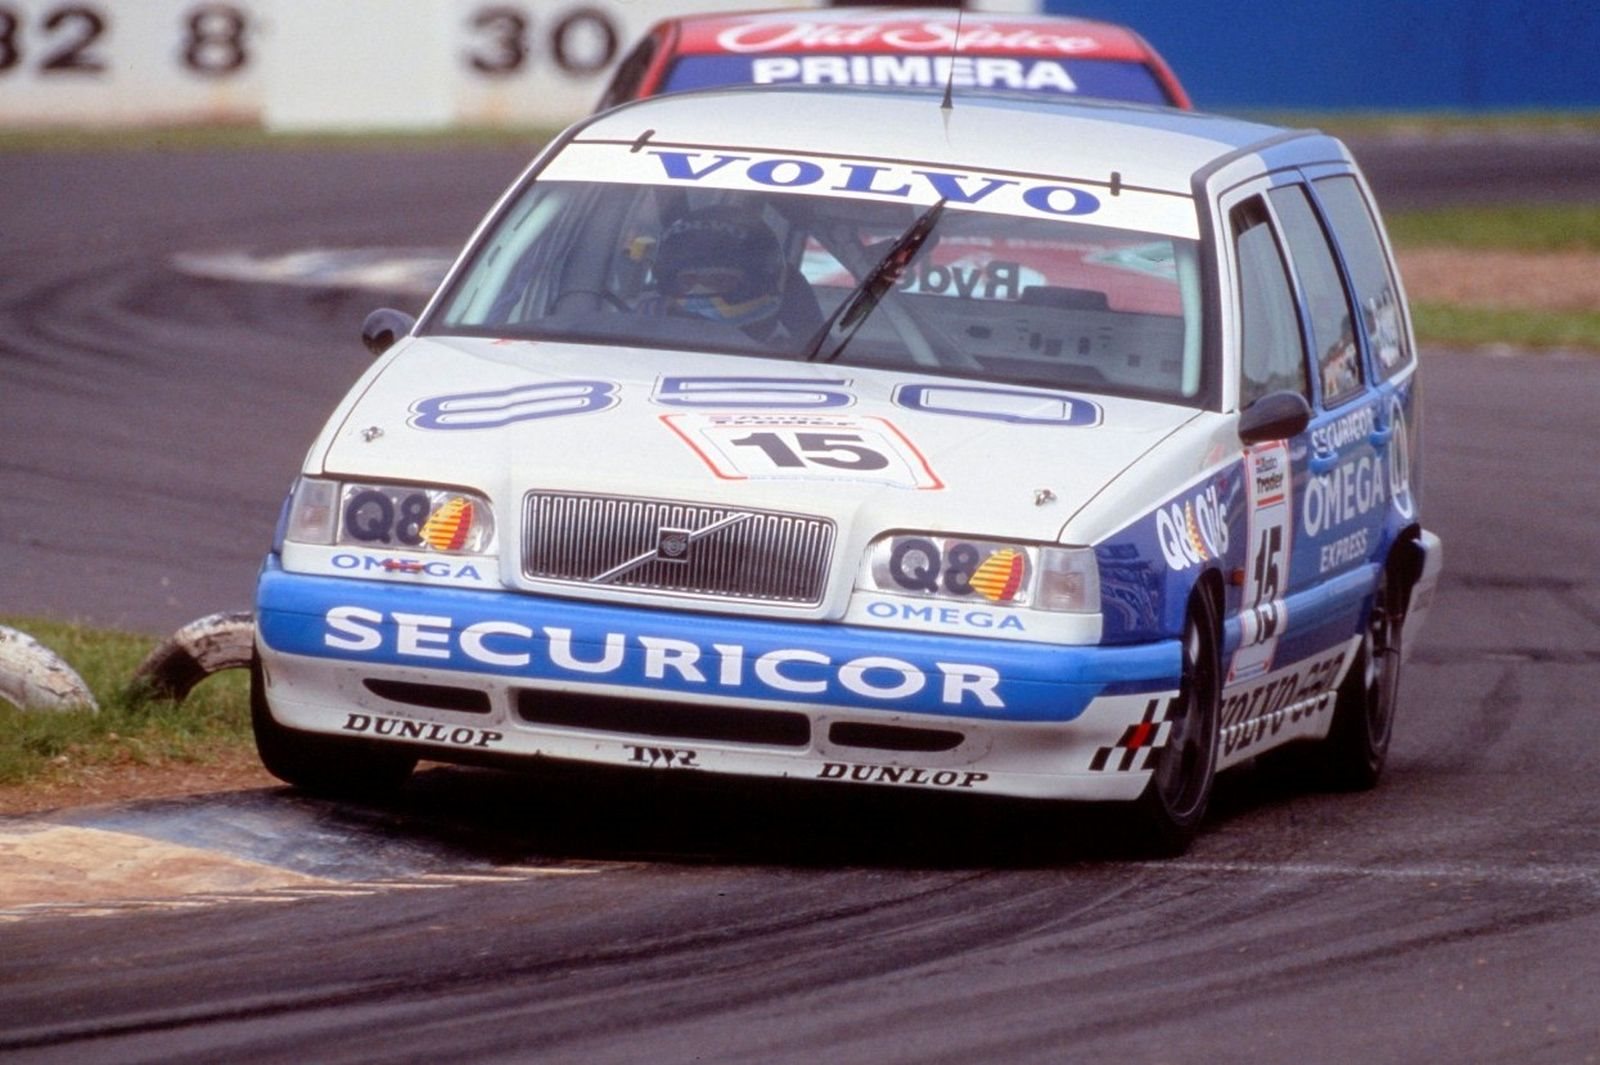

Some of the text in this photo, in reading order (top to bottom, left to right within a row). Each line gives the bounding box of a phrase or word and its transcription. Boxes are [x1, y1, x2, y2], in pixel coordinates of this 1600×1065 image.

[0, 9, 107, 74] 2
[466, 8, 619, 75] 30
[716, 21, 1101, 54] Old Spice
[752, 56, 1078, 93] PRIMERA
[648, 151, 1101, 216] VOLVO
[408, 372, 1105, 432] 850
[730, 432, 889, 471] 15
[345, 490, 432, 545] Q8
[1304, 456, 1387, 537] OMEGA
[1156, 484, 1229, 571] Q8 Oils
[1319, 527, 1371, 574] EXPRESS
[331, 553, 482, 581] OMEGA
[889, 538, 981, 595] Q8
[1252, 525, 1283, 645] 15
[866, 602, 1026, 632] OMEGA
[325, 605, 1007, 708] SECURICOR
[342, 713, 503, 747] DUNLOP
[817, 762, 989, 789] DUNLOP
